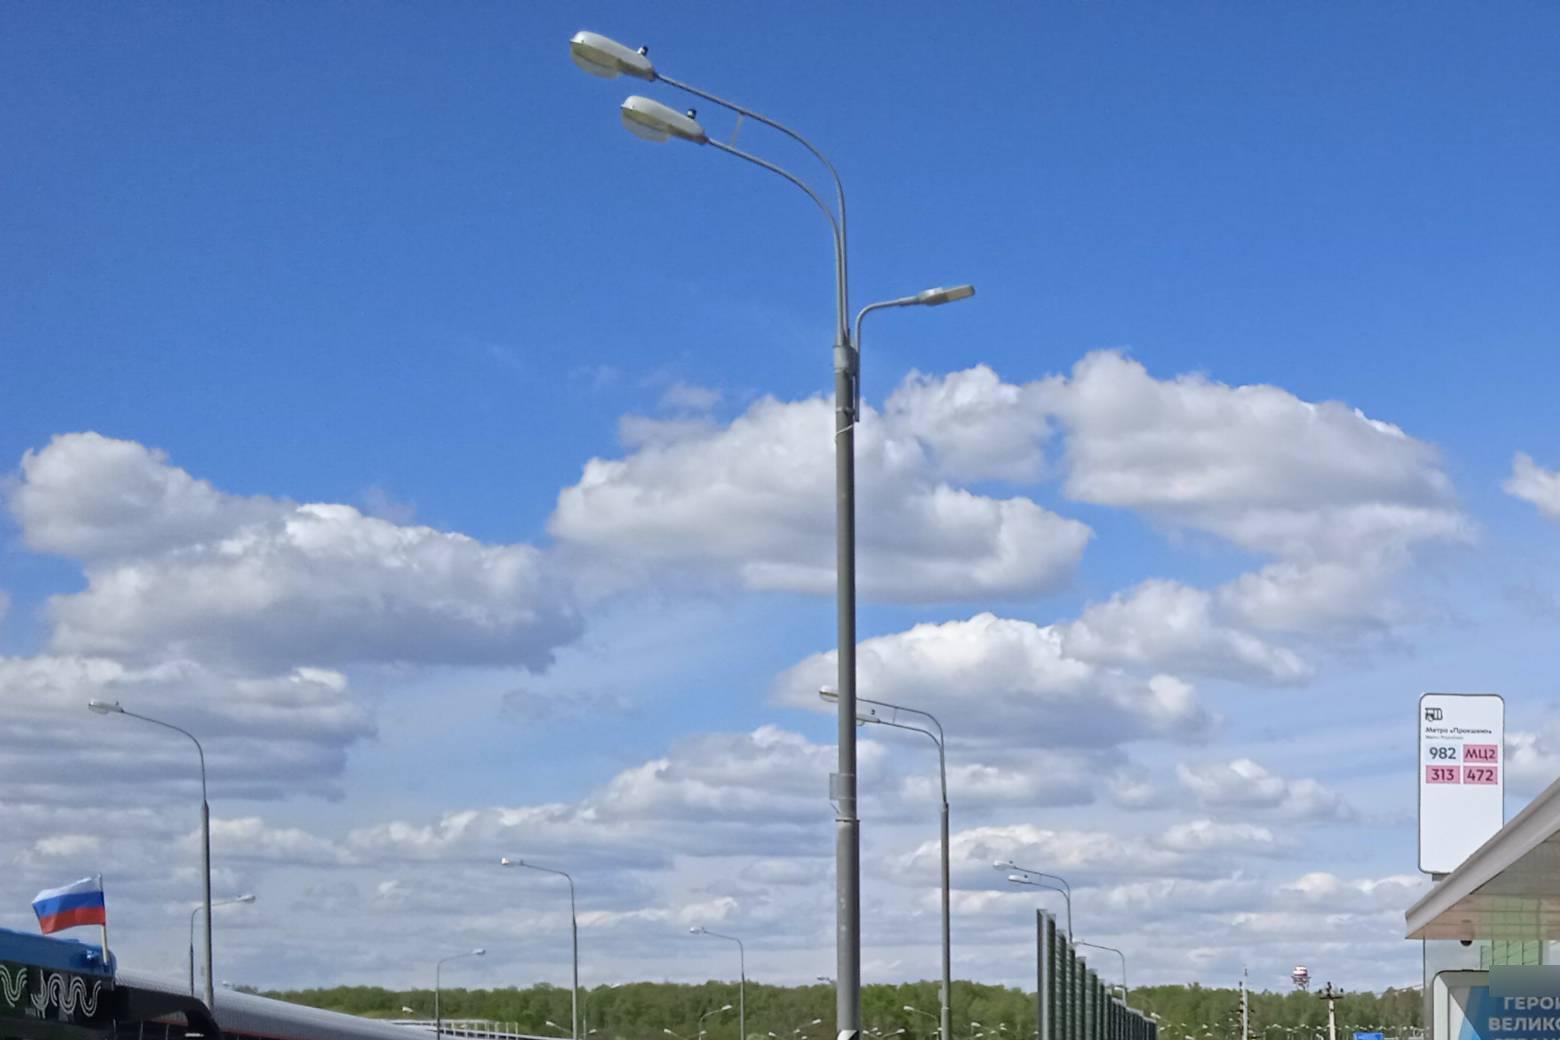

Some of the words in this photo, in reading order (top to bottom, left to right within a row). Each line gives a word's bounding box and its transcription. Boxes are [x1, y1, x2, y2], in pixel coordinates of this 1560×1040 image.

[1429, 747, 1456, 760] 982
[1465, 749, 1495, 760] МЦ2
[1431, 768, 1454, 781] 313
[1467, 769, 1494, 781] 472
